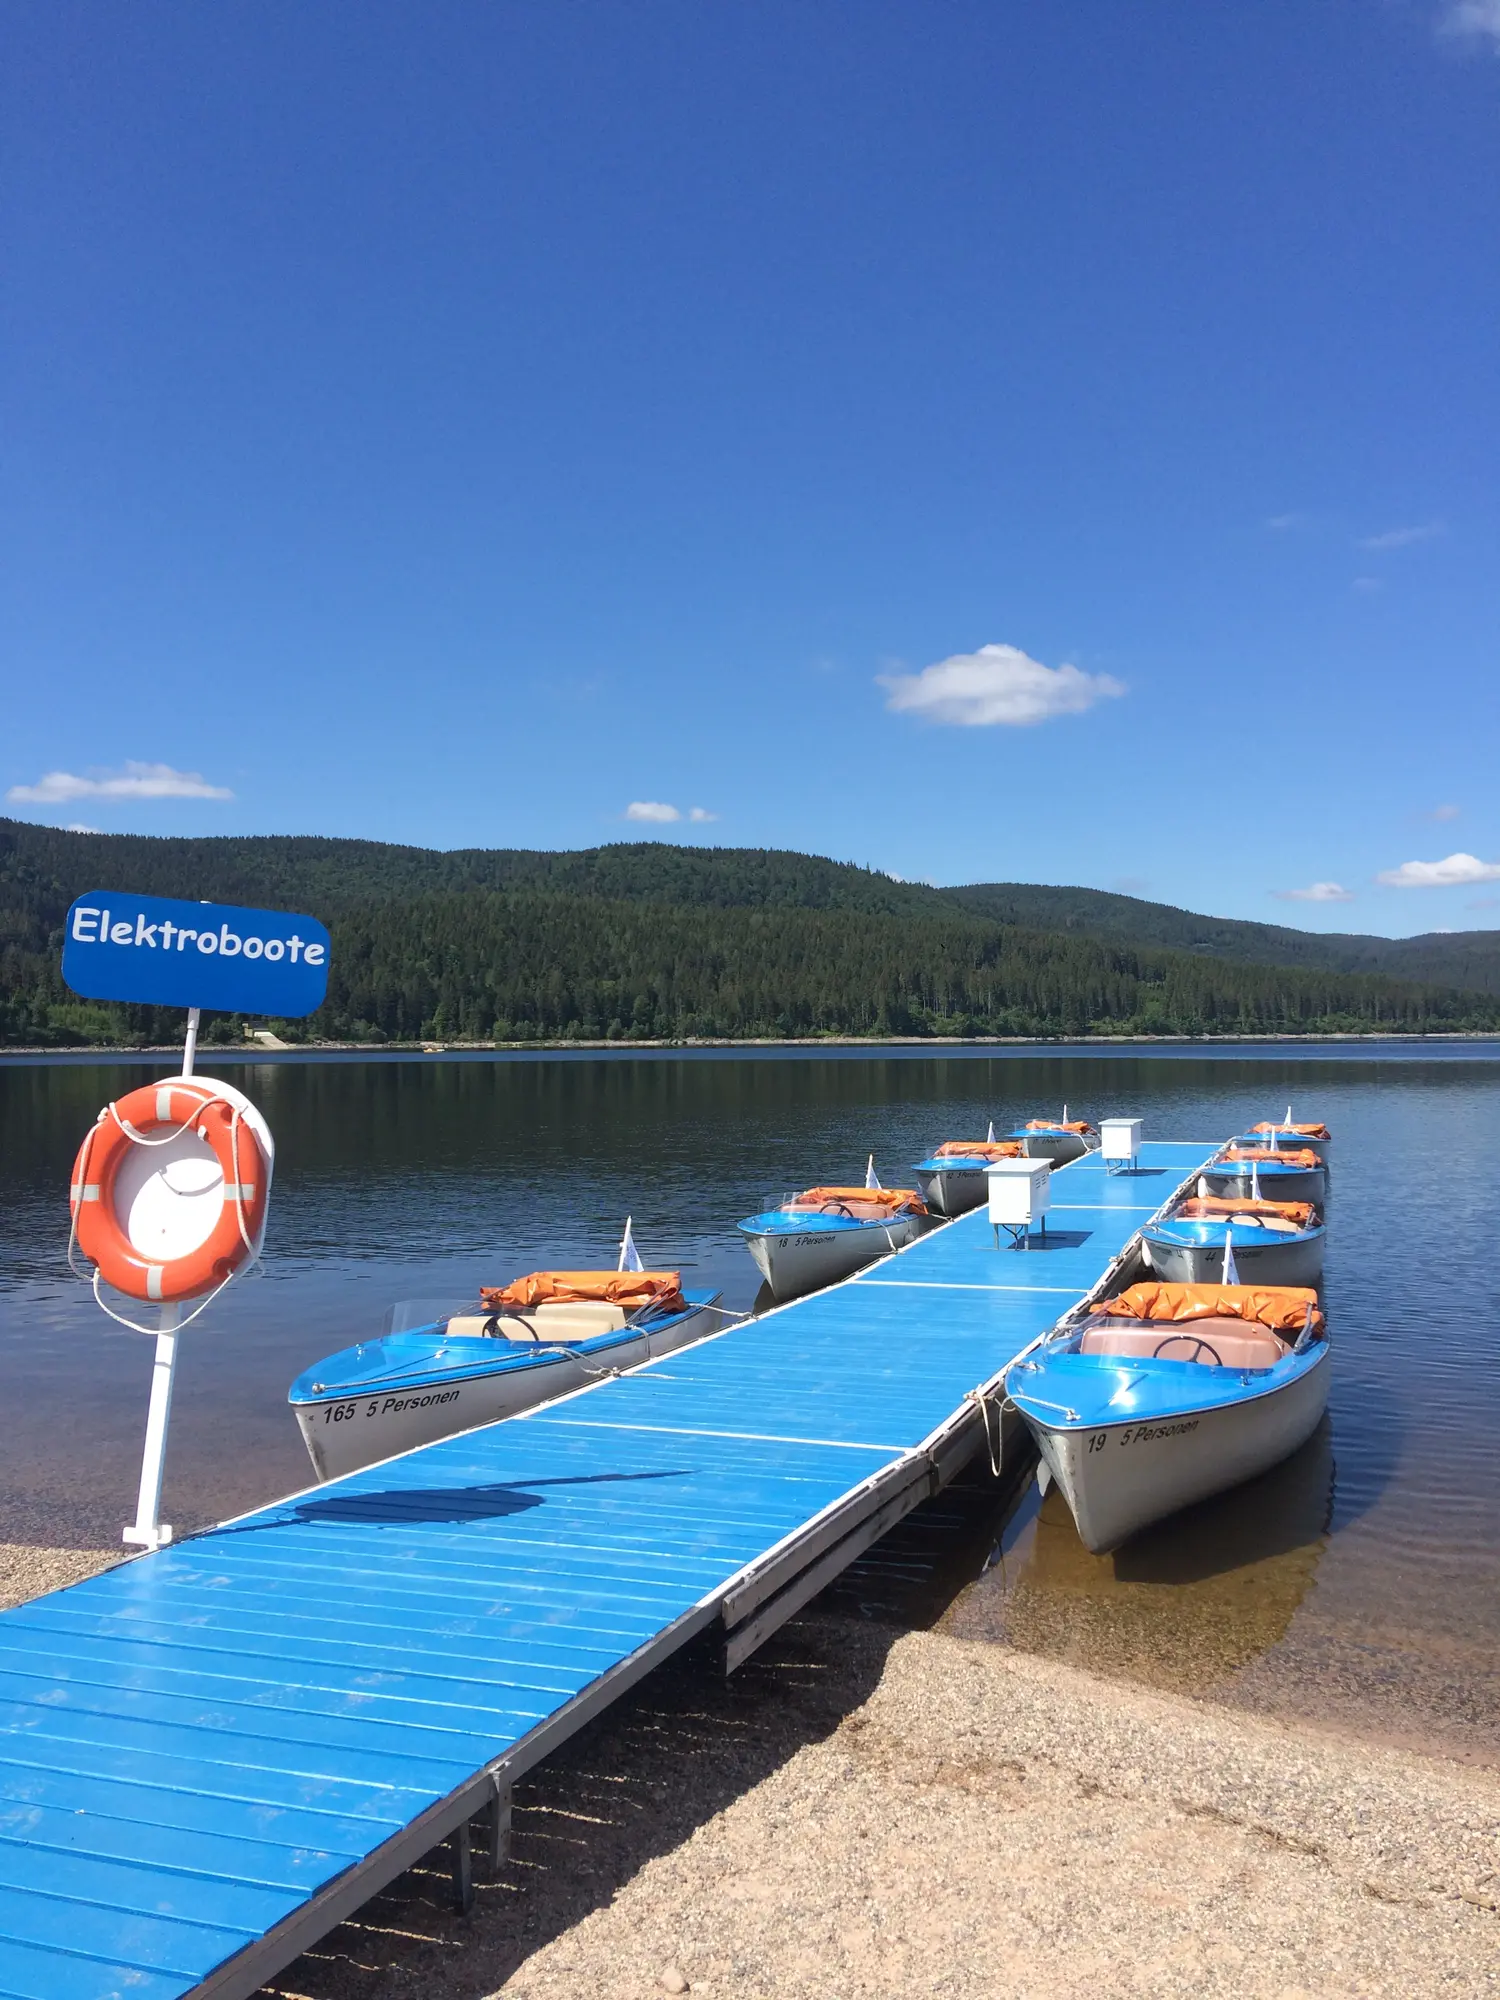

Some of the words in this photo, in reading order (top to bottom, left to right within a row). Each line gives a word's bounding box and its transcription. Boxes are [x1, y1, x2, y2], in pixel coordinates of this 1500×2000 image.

[72, 907, 325, 966] Elektroboote
[778, 1238, 789, 1248] 18
[795, 1237, 801, 1247] 5
[801, 1235, 836, 1246] Personen
[323, 1403, 357, 1424] 165
[366, 1401, 379, 1417] 5
[381, 1390, 460, 1414] Personen
[1088, 1433, 1107, 1454] 19
[1120, 1429, 1133, 1446] 5
[1133, 1419, 1200, 1443] Personen
